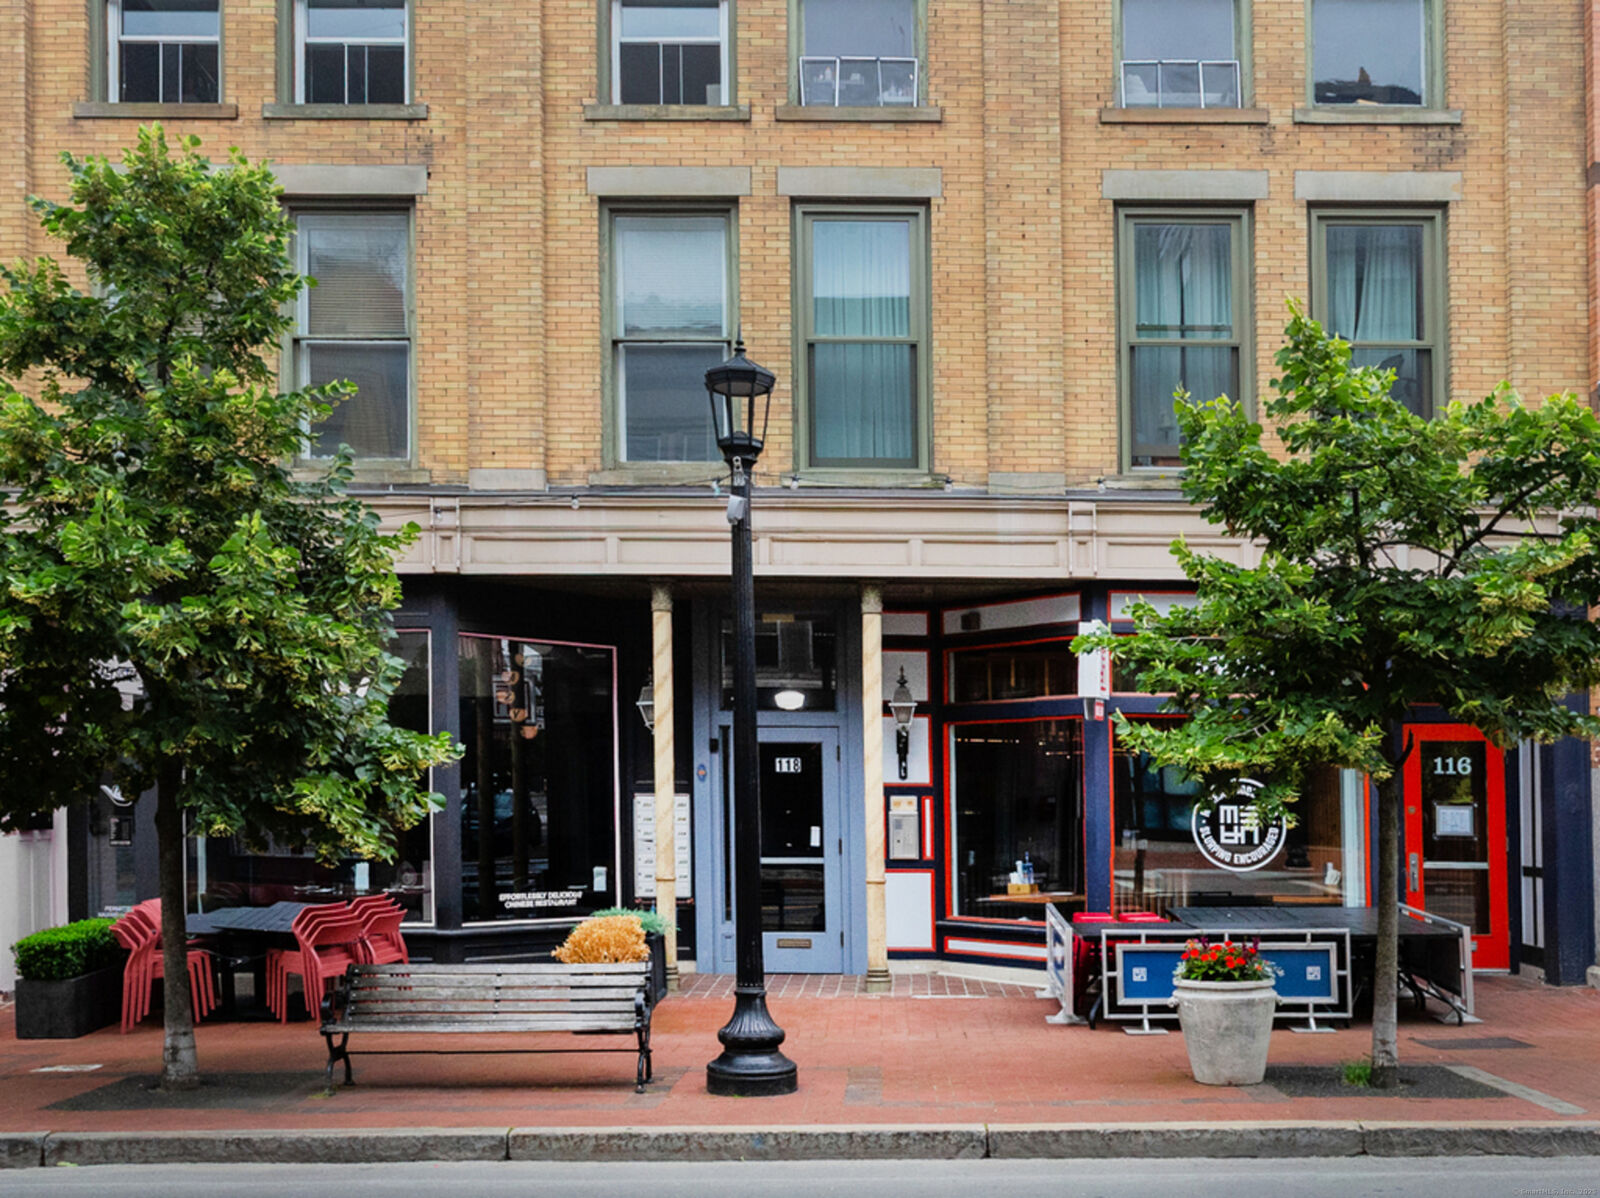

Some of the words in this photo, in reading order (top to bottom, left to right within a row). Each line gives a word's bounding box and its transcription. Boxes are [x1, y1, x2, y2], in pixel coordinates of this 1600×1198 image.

[778, 758, 799, 773] 118
[1433, 756, 1472, 775] 116
[1233, 827, 1279, 864] ENCOURAGED
